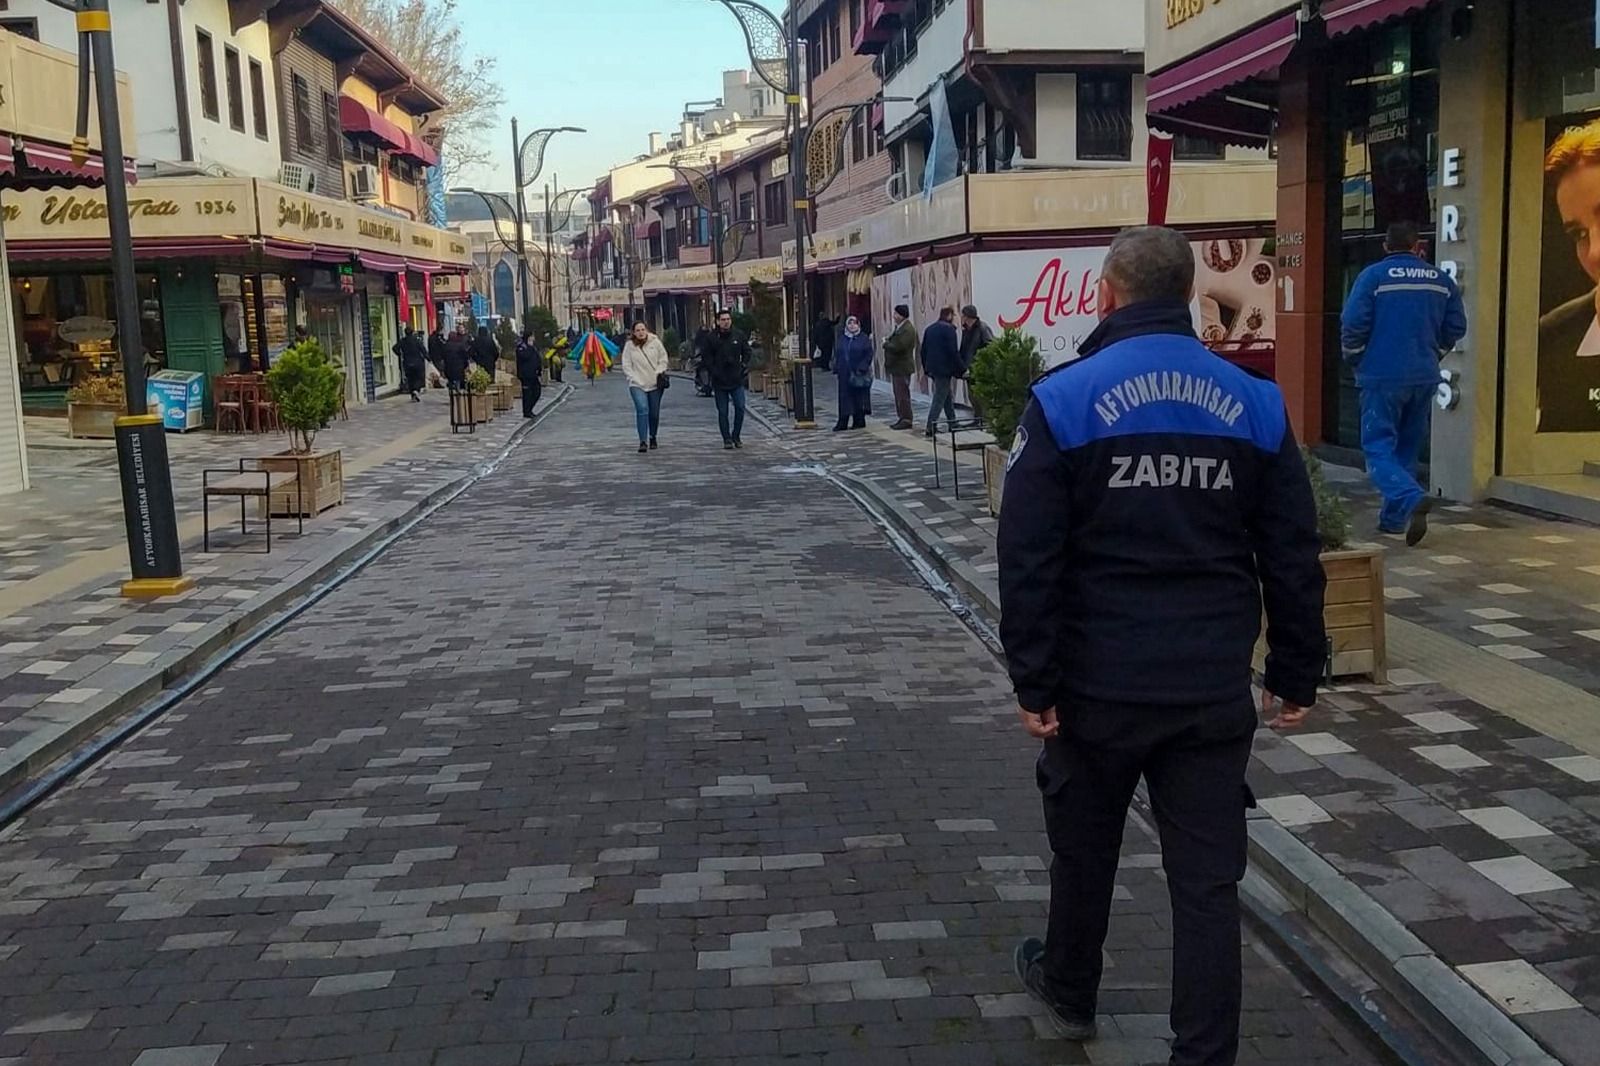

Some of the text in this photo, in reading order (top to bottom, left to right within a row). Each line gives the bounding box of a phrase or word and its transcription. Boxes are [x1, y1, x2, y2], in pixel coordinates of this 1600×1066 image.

[196, 200, 236, 215] 1934
[998, 258, 1098, 328] Akk
[1040, 335, 1082, 352] LOK
[1108, 454, 1234, 491] ZABITA
